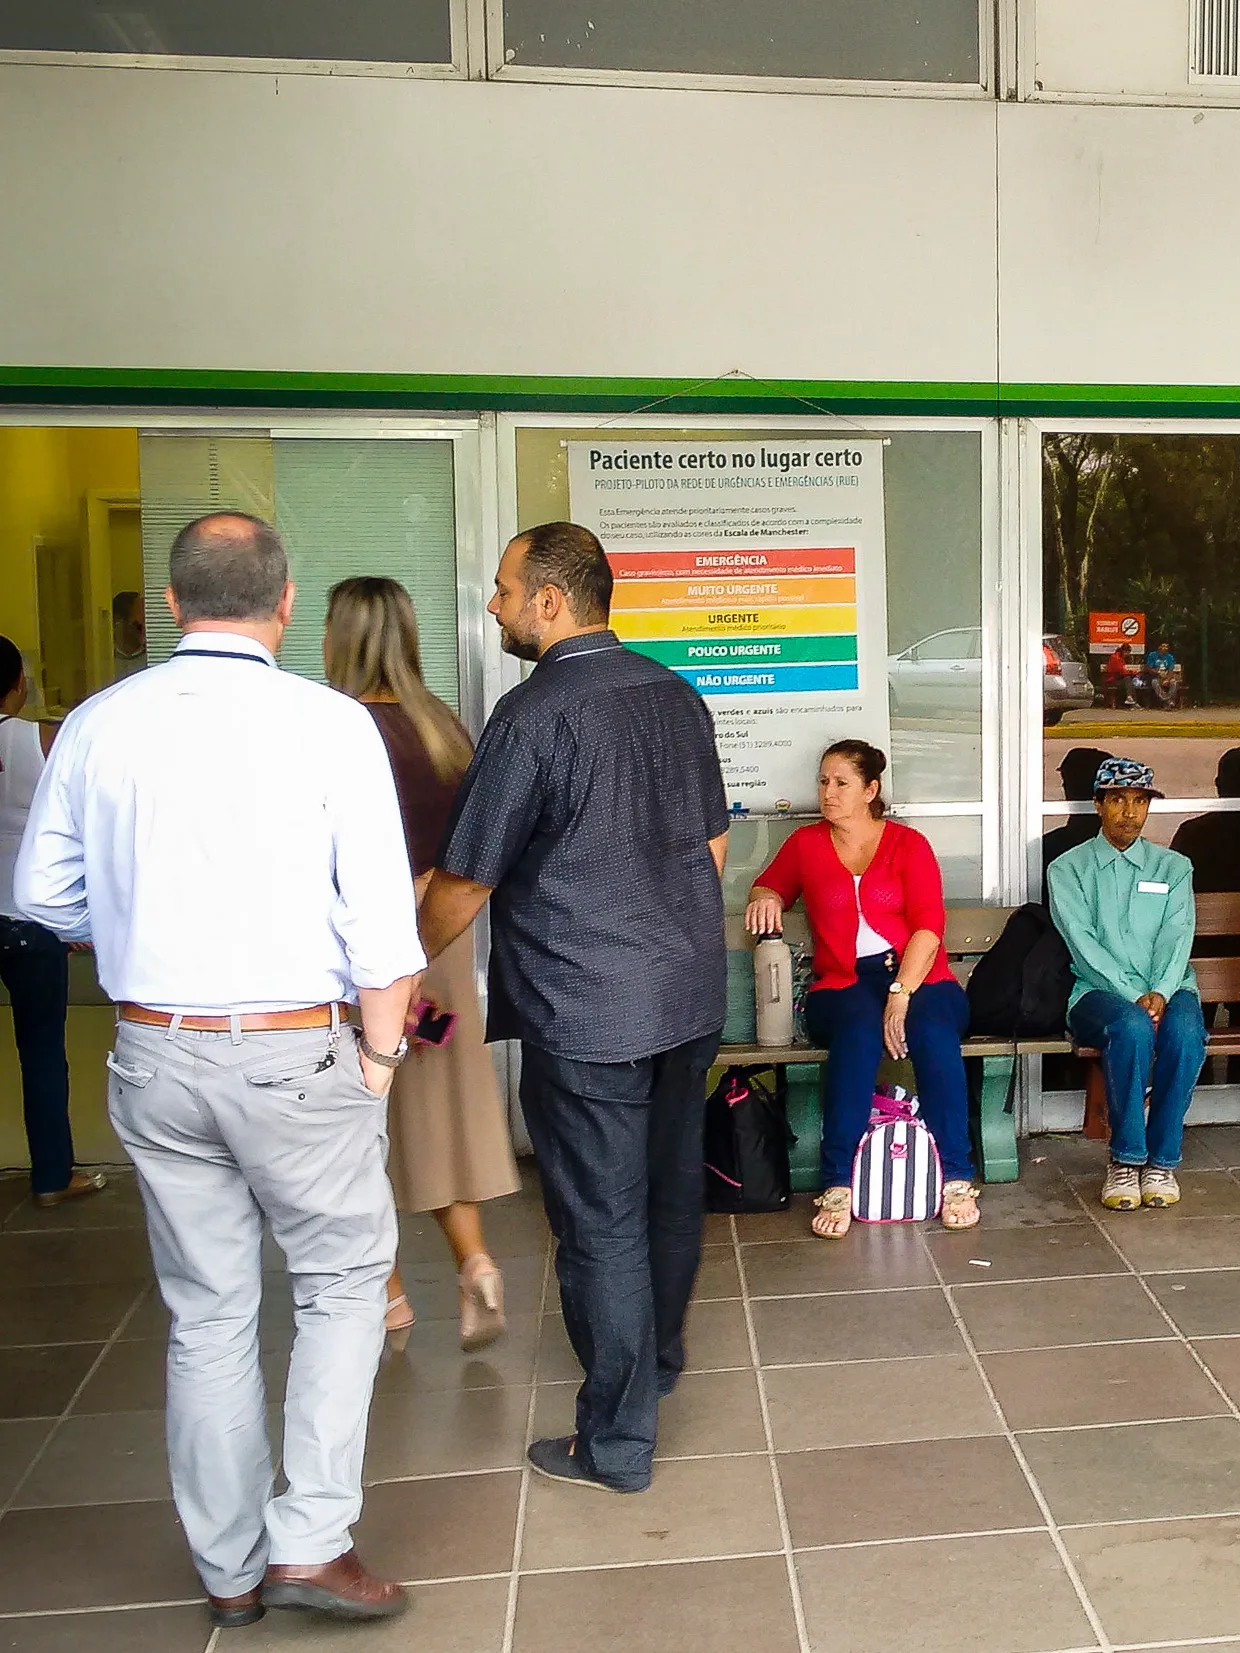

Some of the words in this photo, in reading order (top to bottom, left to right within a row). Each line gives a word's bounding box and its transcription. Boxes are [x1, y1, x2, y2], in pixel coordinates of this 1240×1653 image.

[590, 449, 673, 470] Paciente
[678, 450, 727, 469] certo
[732, 453, 755, 468] no
[761, 448, 811, 473] lugar
[815, 448, 863, 467] certo
[595, 478, 665, 490] PROJETO-PILOTO
[667, 478, 679, 489] DA
[681, 478, 703, 489] REDE
[705, 477, 716, 489] DE
[718, 475, 766, 488] URGÊNCIAS
[768, 476, 773, 487] E
[775, 475, 834, 487] EMERGÊNCIAS
[835, 475, 860, 488] (RUE)
[599, 508, 615, 516] Esta
[661, 507, 687, 515] atende
[611, 521, 648, 530] pacientes
[648, 520, 661, 528] são
[750, 518, 760, 526] de
[761, 518, 787, 526] acordo
[713, 530, 723, 538] da
[723, 528, 748, 537] Escala
[749, 528, 759, 536] de
[760, 527, 809, 537] Manchester:
[695, 554, 768, 567] EMERGÊNCIA
[687, 585, 725, 596] MUITO
[726, 584, 778, 595] URGENTE
[708, 613, 759, 623] URGENTE
[688, 646, 728, 657] POUCO
[729, 644, 782, 656] URGENTE
[696, 673, 722, 687] NÃO
[723, 673, 775, 686] URGENTE
[717, 708, 744, 716] verdes
[775, 706, 789, 714] são
[846, 705, 863, 714] para
[736, 730, 749, 738] Sul
[727, 780, 740, 788] sua
[741, 779, 767, 790] região
